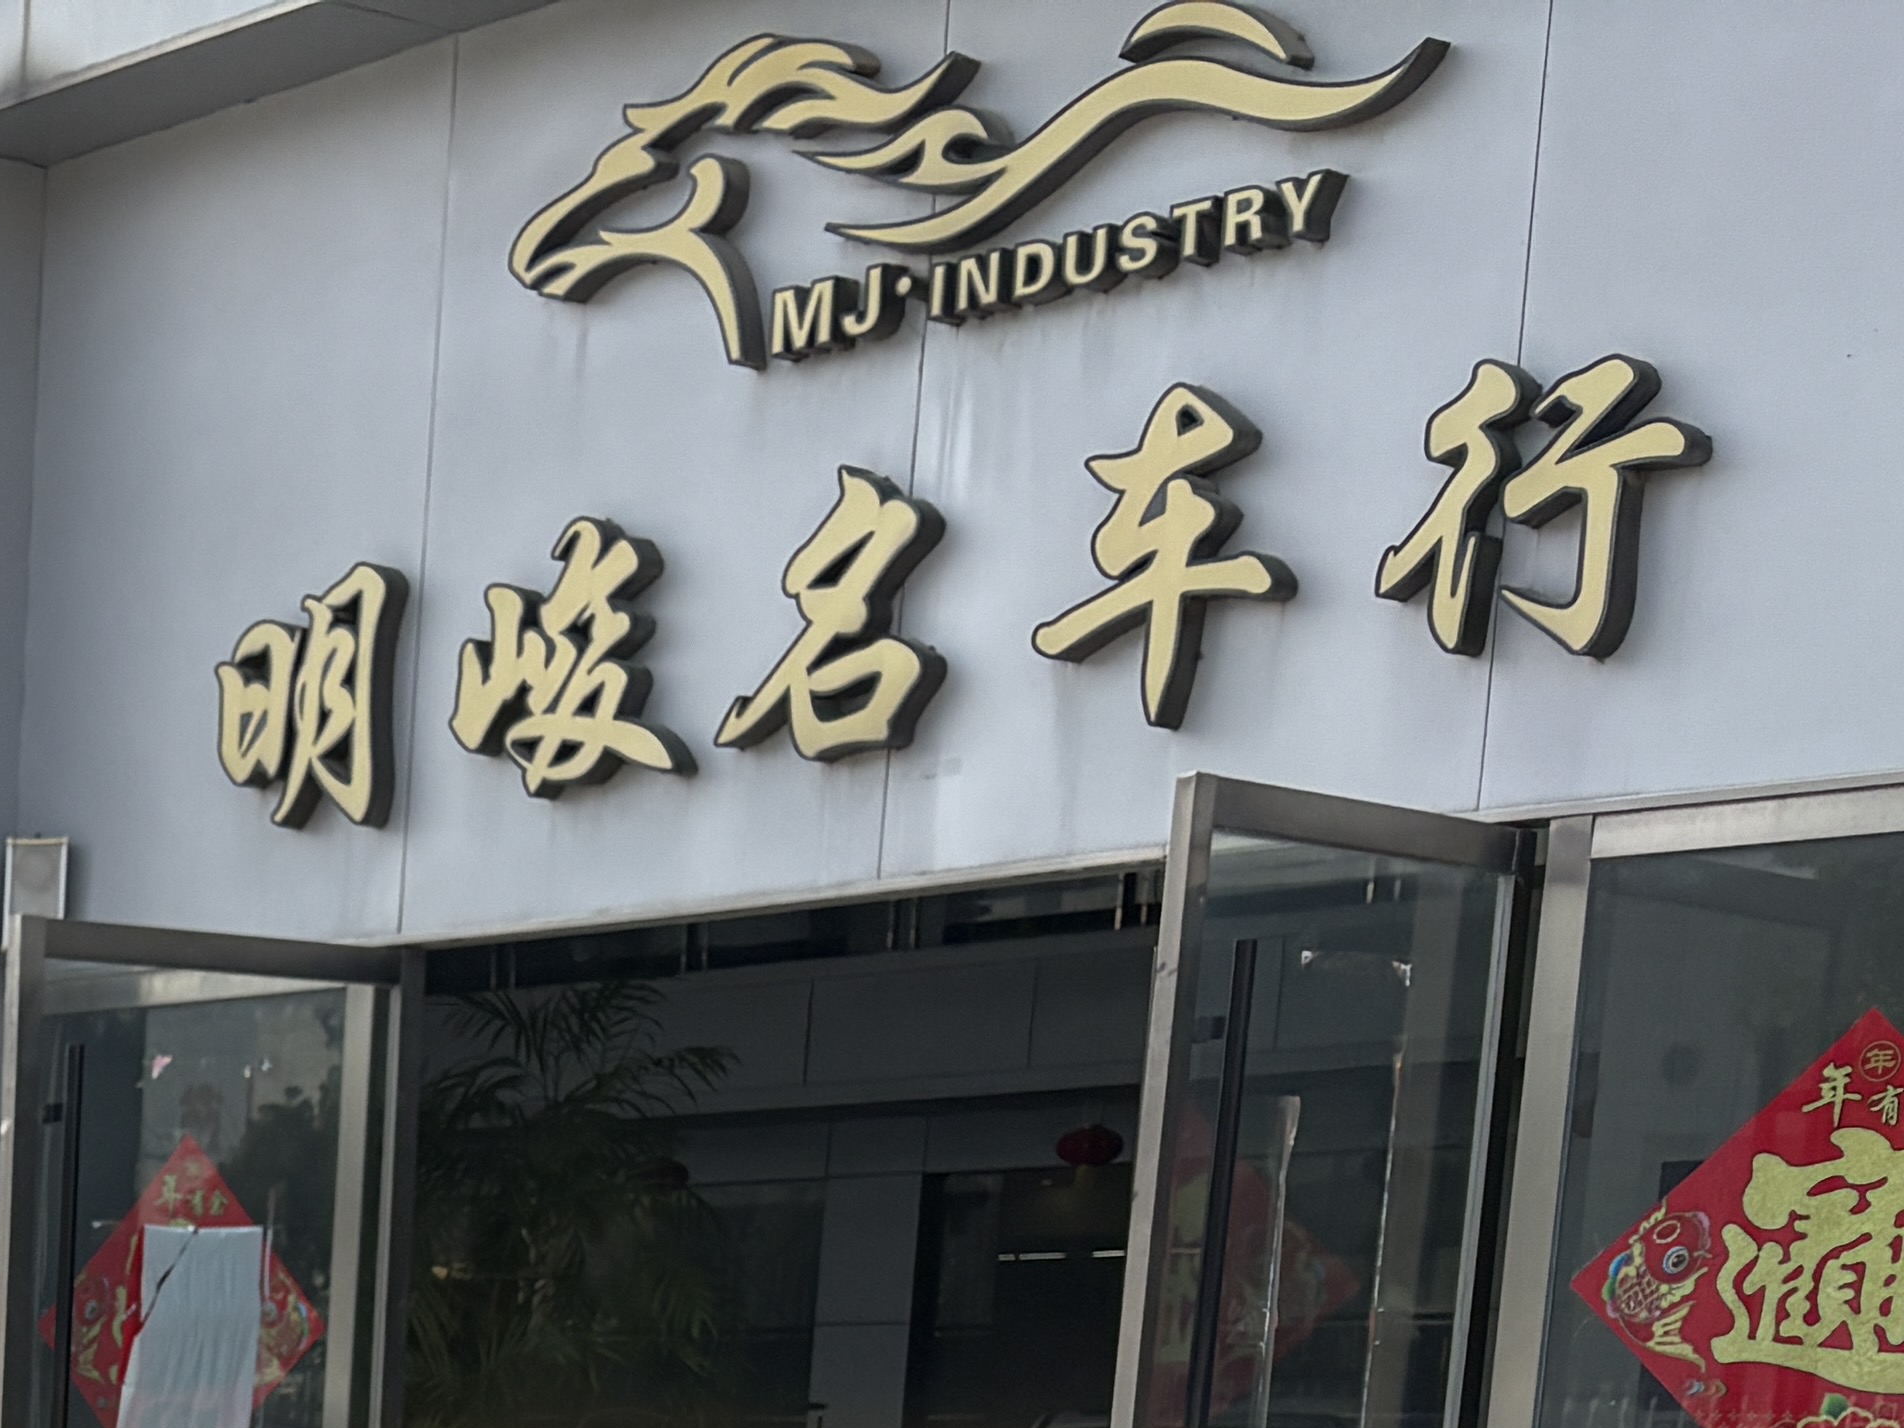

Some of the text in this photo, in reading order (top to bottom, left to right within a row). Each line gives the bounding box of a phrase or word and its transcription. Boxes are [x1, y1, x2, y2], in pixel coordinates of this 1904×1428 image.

[216, 354, 1692, 826] 明峻名车行
